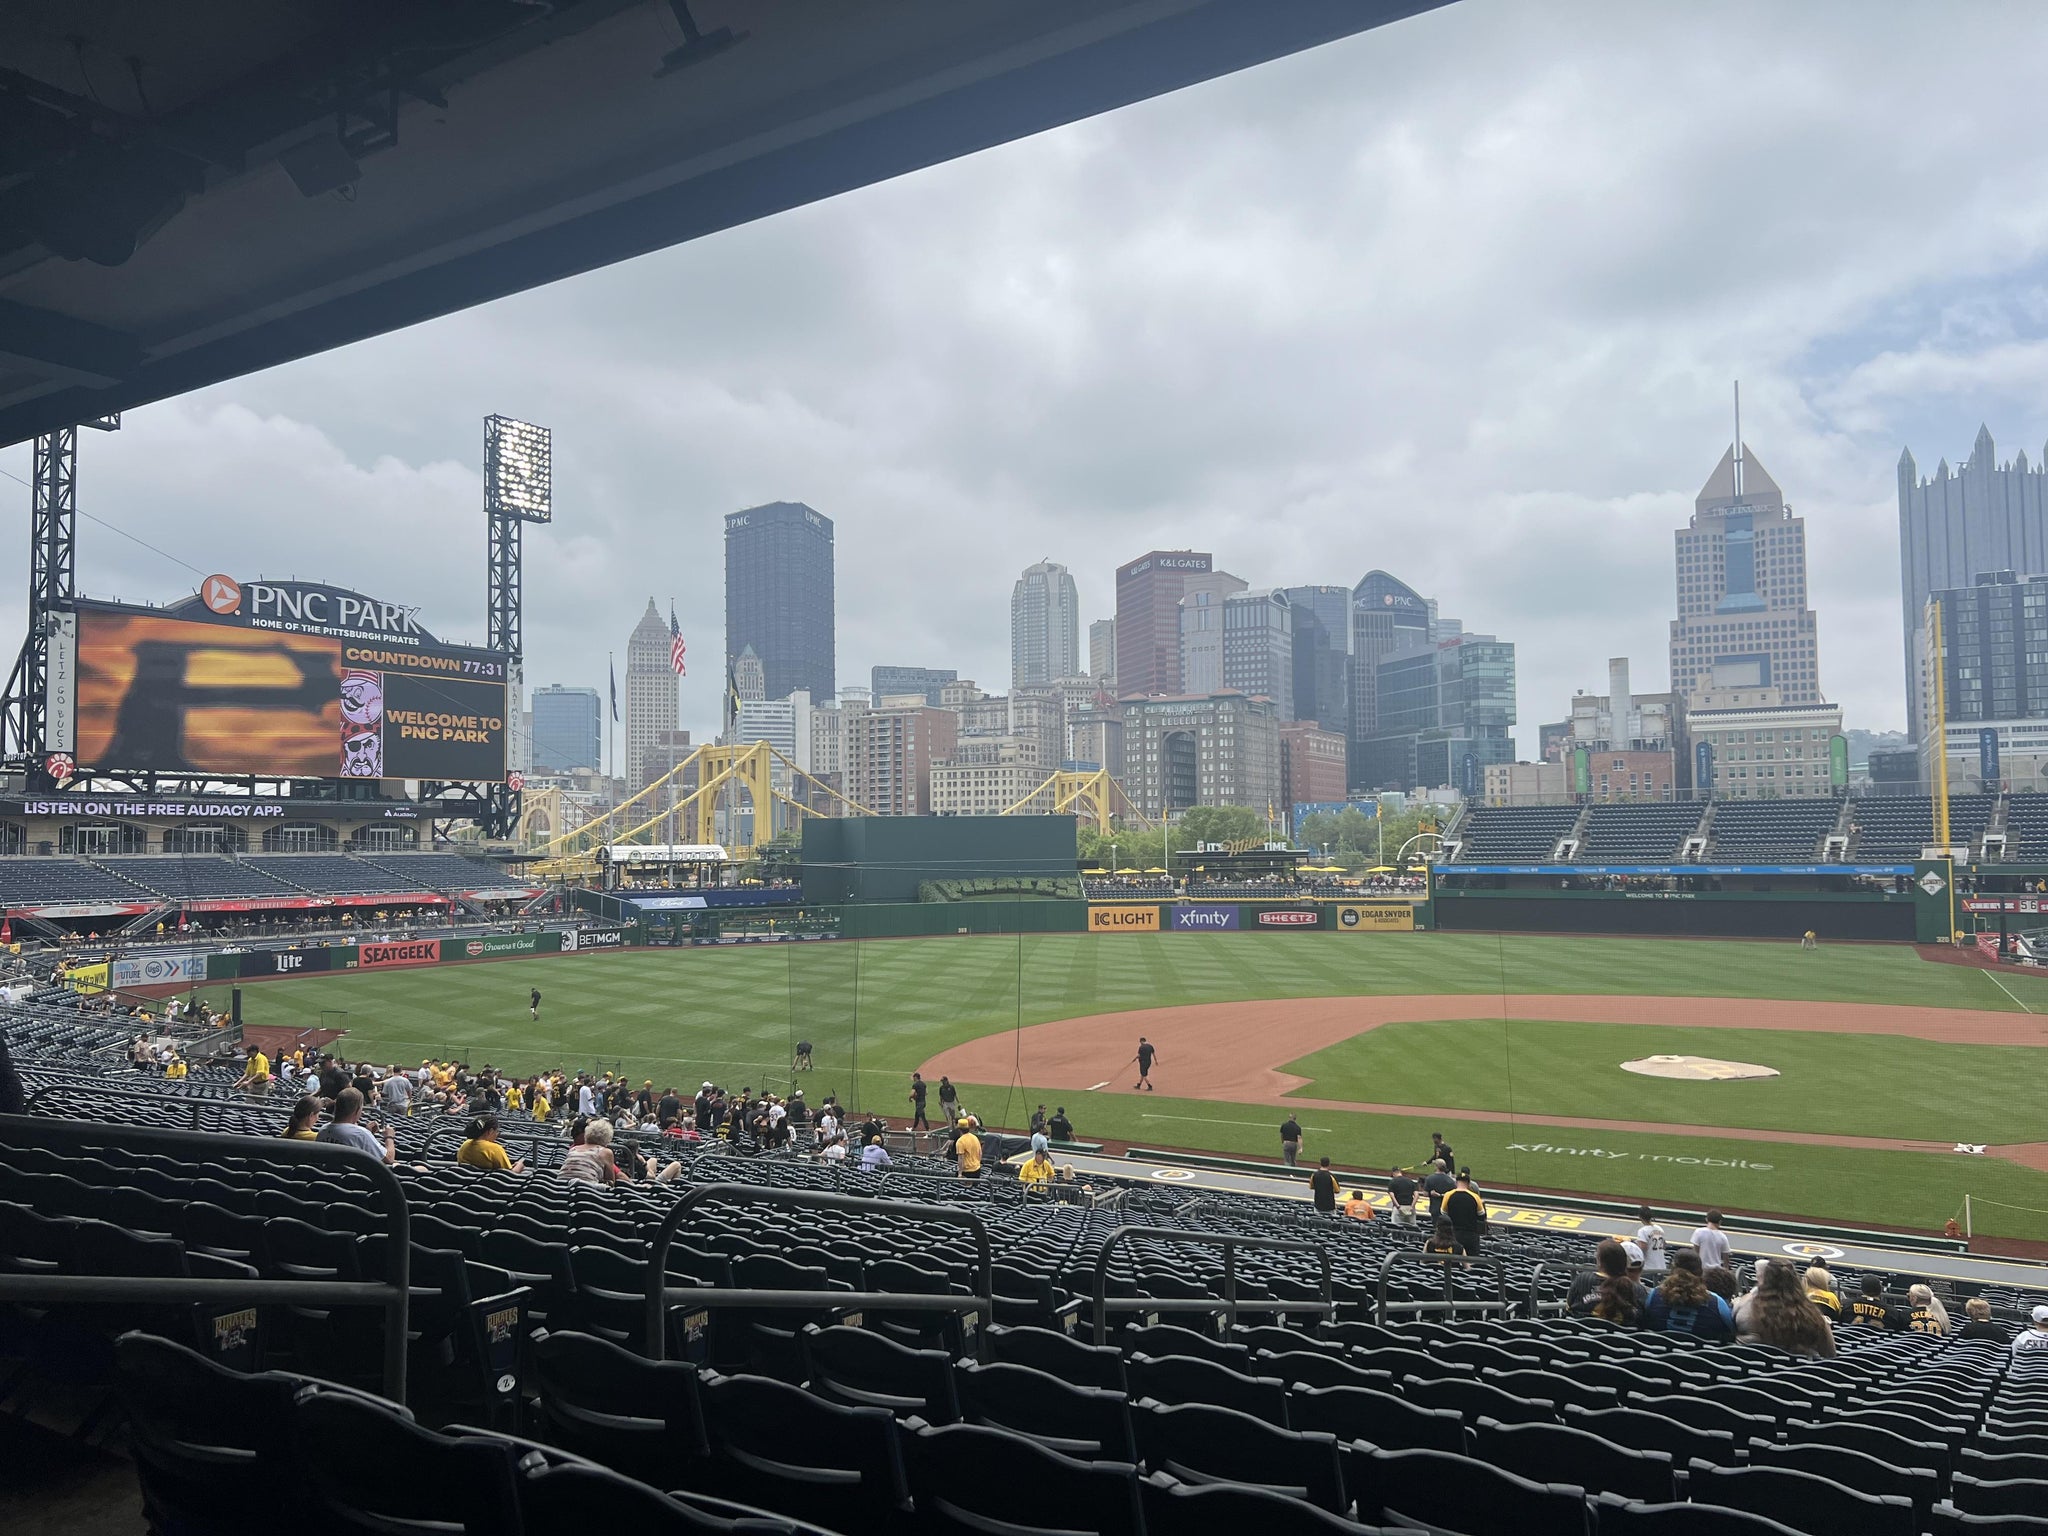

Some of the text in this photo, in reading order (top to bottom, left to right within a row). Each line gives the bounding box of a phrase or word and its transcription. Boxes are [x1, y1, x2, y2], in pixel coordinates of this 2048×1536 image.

[725, 515, 750, 529] UPMC
[805, 511, 821, 528] UPMC
[1160, 559, 1206, 569] K&L GATES
[248, 584, 422, 634] PNC PARK
[1353, 599, 1365, 608] PNC
[1395, 595, 1412, 607] PNC
[252, 618, 420, 646] HOME OF THE PITTSBURGH PIRATES
[58, 641, 66, 680] LETZ
[346, 648, 502, 676] COUNTDOWN 77:31
[57, 686, 65, 704] GO
[386, 710, 502, 731] WELCOME TO
[401, 726, 490, 743] PNC PARK
[24, 802, 285, 817] LISTEN ON THE FREE AUDACY APP.
[1264, 842, 1287, 851] TIME
[1094, 912, 1154, 925] IC LIGHT
[1180, 910, 1230, 927] xfinity
[1263, 914, 1313, 923] SHEETZ
[1362, 911, 1383, 919] EDGAR
[1385, 910, 1411, 919] SNYDER
[517, 939, 536, 949] Good
[579, 932, 621, 945] BETMGM
[364, 943, 435, 964] SEATGEEK
[181, 958, 204, 976] 125
[276, 954, 302, 972] Lite
[1505, 1143, 1774, 1170] xfinity mobile
[1853, 1303, 1886, 1319] BUTTER
